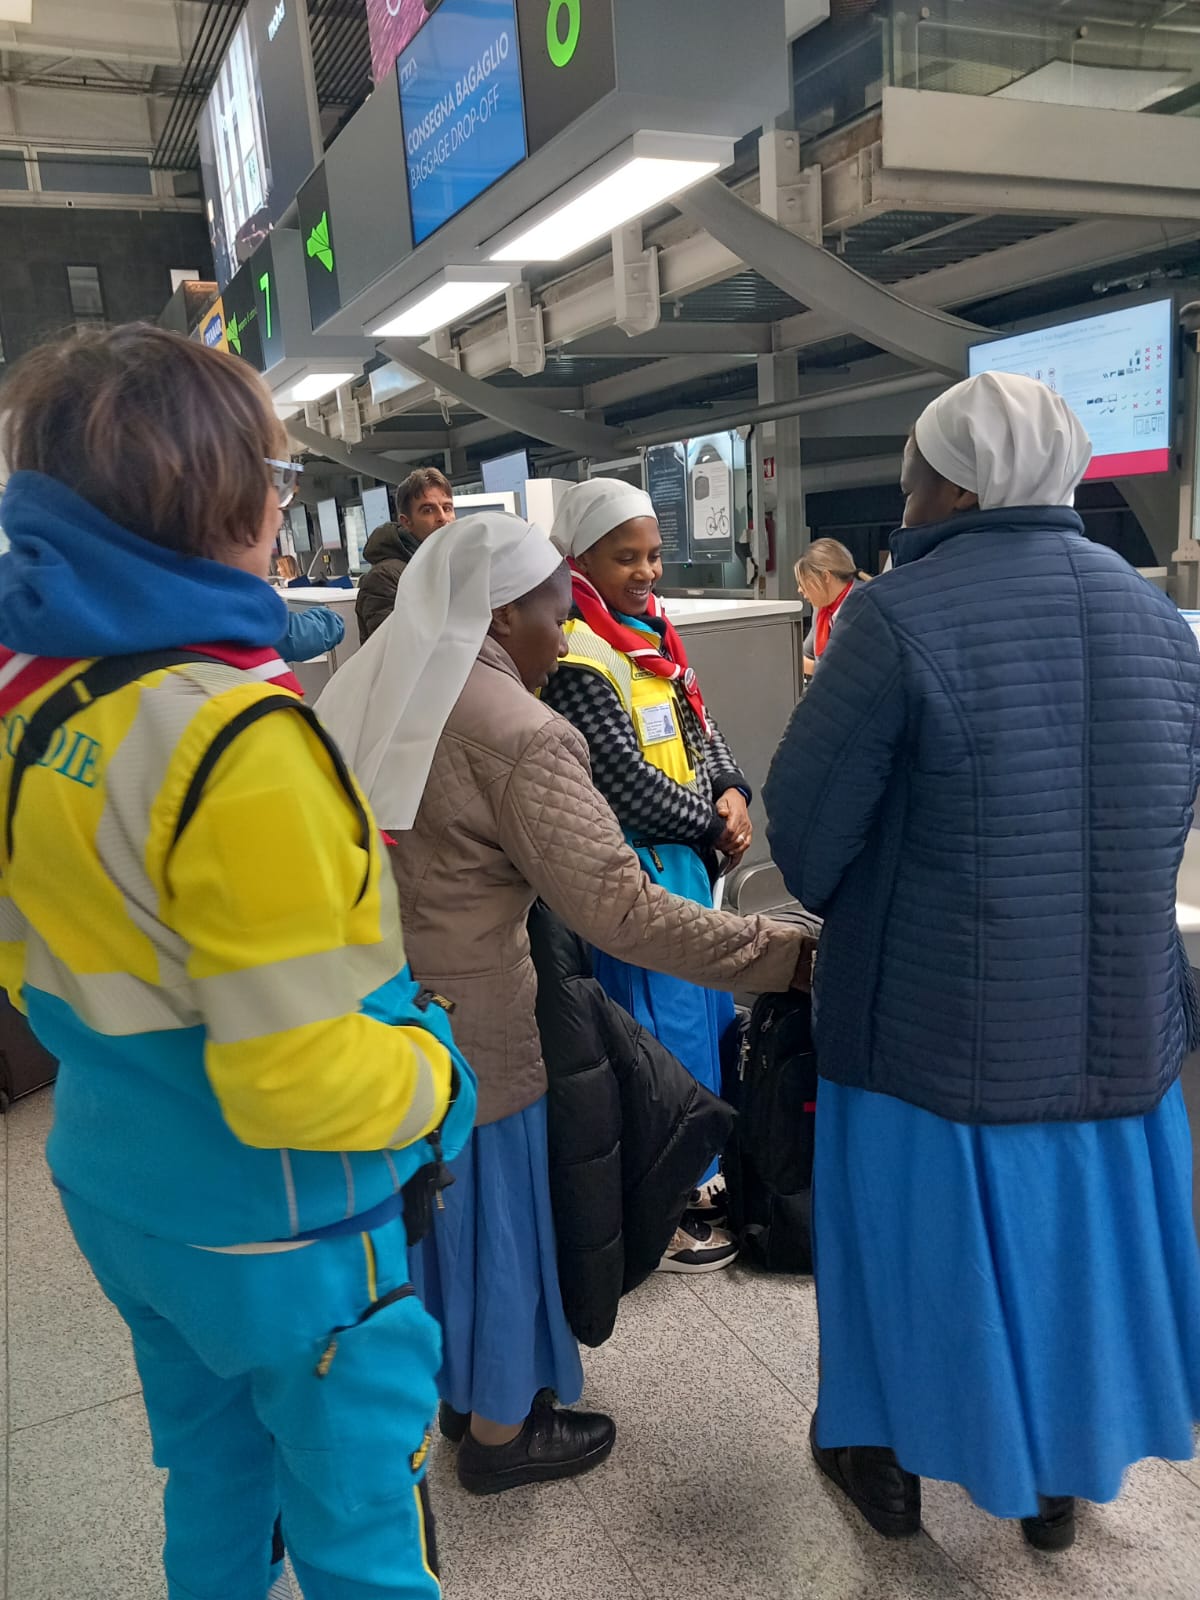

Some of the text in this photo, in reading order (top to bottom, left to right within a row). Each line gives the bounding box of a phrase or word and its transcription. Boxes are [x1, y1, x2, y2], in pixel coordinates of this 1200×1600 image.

[407, 32, 508, 155] CONSEGNA BAGAGLIO
[410, 83, 500, 190] BAGGAGE DROP-OFF
